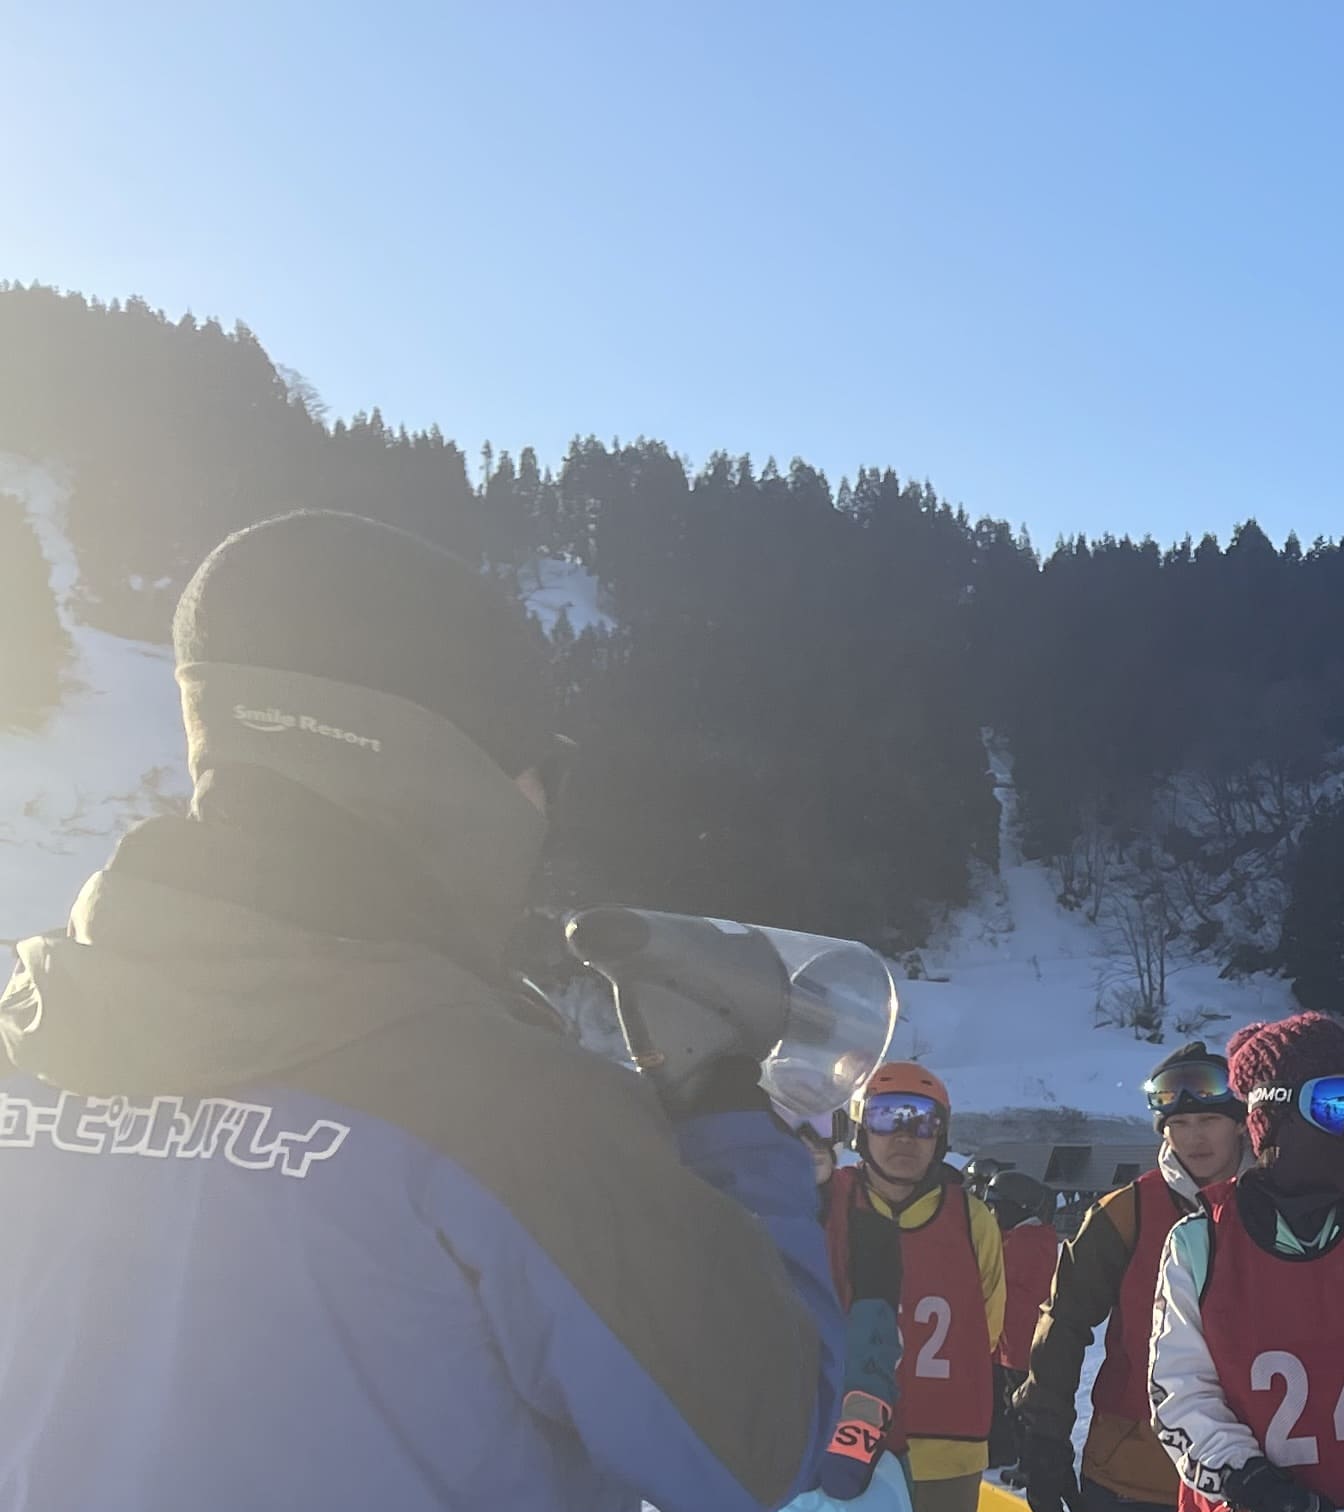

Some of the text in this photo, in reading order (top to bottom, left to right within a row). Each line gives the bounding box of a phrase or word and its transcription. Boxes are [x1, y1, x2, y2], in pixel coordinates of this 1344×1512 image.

[232, 703, 382, 752] Smile Resort
[0, 1090, 351, 1178] ューピットバレイ
